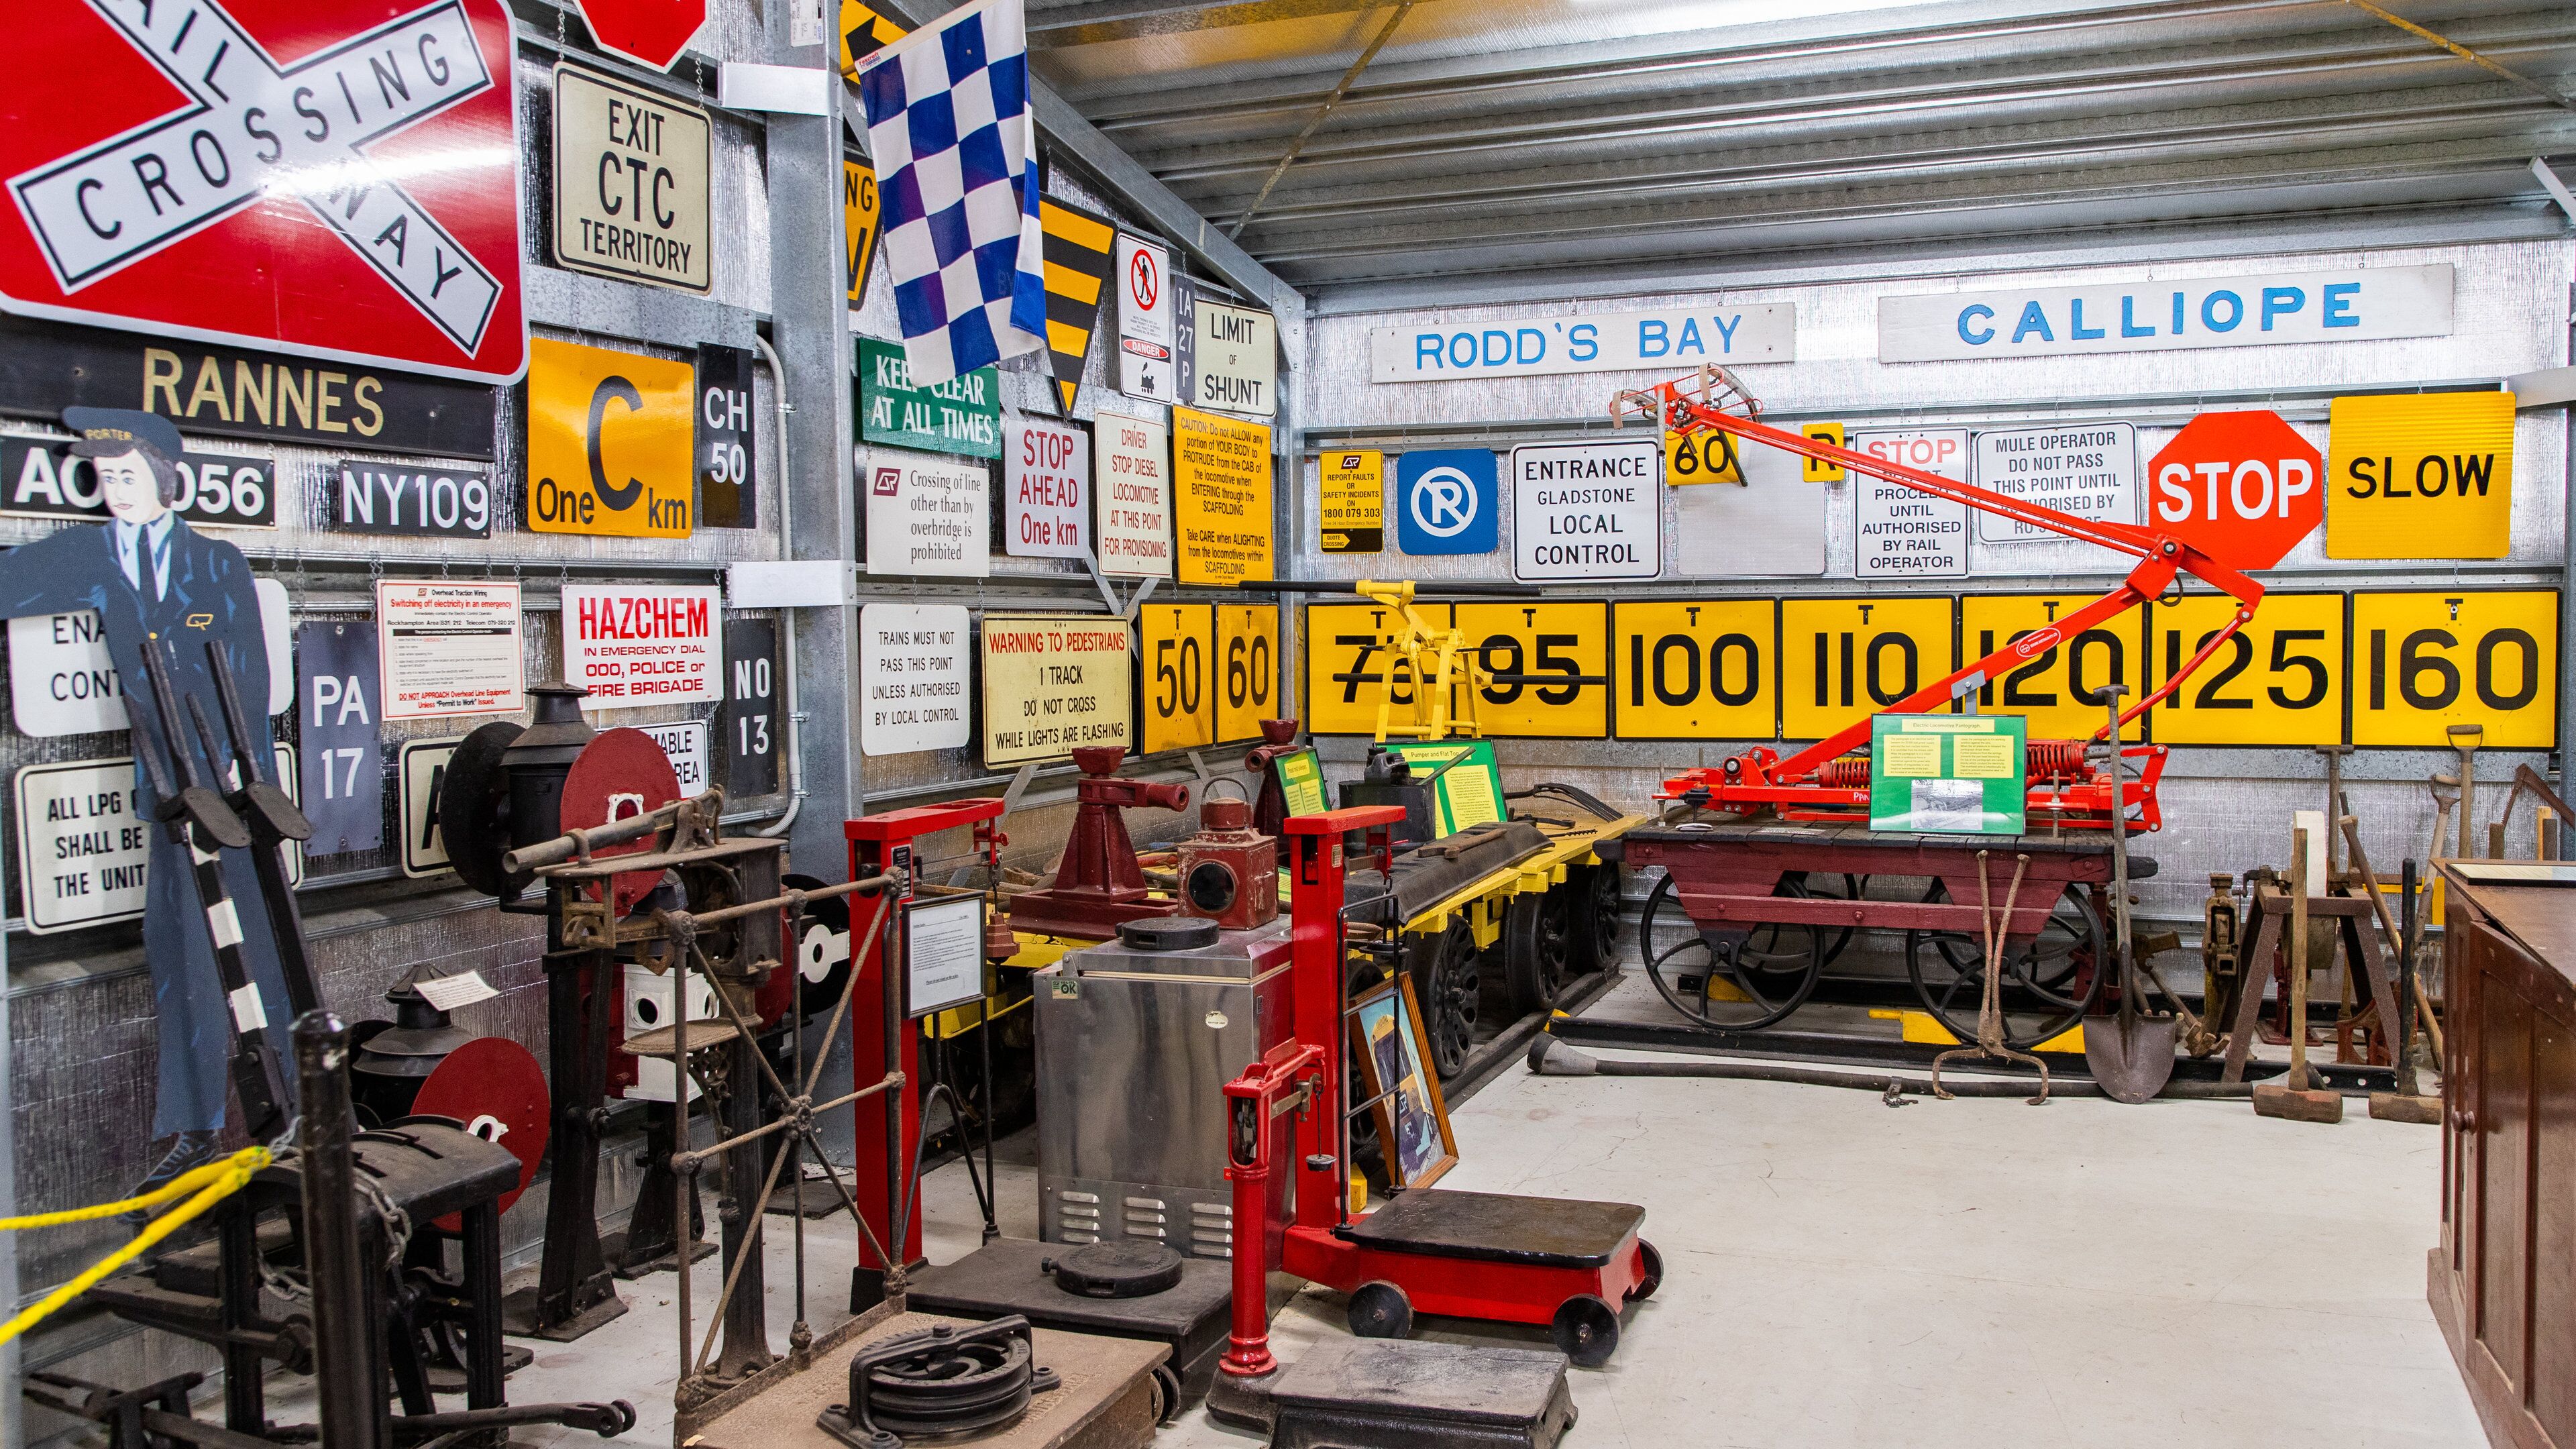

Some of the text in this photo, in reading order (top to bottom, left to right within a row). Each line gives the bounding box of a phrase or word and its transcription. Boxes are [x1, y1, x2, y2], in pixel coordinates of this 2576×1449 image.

[76, 34, 450, 240] CROSSING
[609, 98, 665, 156] EXIT
[599, 152, 675, 229] CTC
[580, 218, 691, 274] TERRITORY
[1957, 282, 2361, 345] CALLIOPE
[1178, 325, 1193, 354] 27
[1212, 313, 1254, 344] LIMIT
[1132, 341, 1160, 358] DANGER
[1417, 315, 1741, 370] RODD'S BAY
[1229, 354, 1236, 365] OF
[1182, 361, 1190, 387] P
[144, 348, 383, 436] RANNES
[930, 374, 985, 406] CLEAR
[1205, 374, 1262, 406] SHUNT
[705, 387, 747, 431] CH
[872, 396, 994, 445] AT ALL TIMES
[85, 429, 133, 441] PORTER
[588, 375, 643, 511] C
[1122, 429, 1146, 449] DRIVER
[1231, 427, 1251, 441] ALLOW
[1996, 431, 2116, 453] MULE OPERATOR
[1023, 429, 1073, 470] STOP
[1183, 450, 1215, 466] PROTRUDE
[1674, 435, 1729, 475] 60
[1868, 439, 1956, 464] STOP
[711, 443, 746, 484] 50
[1112, 455, 1158, 478] STOP DIESEL
[1525, 457, 1647, 480] ENTRANCE
[2009, 453, 2103, 472] DO NOT PASS
[911, 470, 981, 494] Crossing line
[1205, 469, 1235, 484] locomotive
[1993, 473, 2121, 494] THIS POINT UNTIL
[2347, 453, 2494, 498] SLOW
[343, 471, 490, 531] NY109
[1019, 473, 1077, 508] AHEAD
[1113, 483, 1159, 504] LOCOMOTIVE
[1191, 483, 1220, 498] ENTERING
[1538, 488, 1635, 505] GLADSTONE
[2097, 494, 2115, 508] BY
[2157, 459, 2312, 523] STOP
[537, 478, 686, 529] One km
[911, 494, 961, 513] other than
[1203, 500, 1243, 516] SCAFFOLDING
[1324, 509, 1342, 518] 1800
[1890, 505, 1933, 517] UNTIL
[911, 519, 962, 541] overbridge
[1021, 513, 1077, 545] One km
[1123, 511, 1161, 531] THIS POINT
[1550, 514, 1623, 535] LOCAL
[1862, 521, 1961, 535] AUTHORISED
[1105, 537, 1167, 558] FOR PROVISIONING
[1233, 533, 1265, 547] ALIGHTING
[1883, 539, 1941, 551] BY RAIL
[911, 542, 961, 564] prohibited
[1535, 544, 1640, 566] CONTROL
[1870, 556, 1953, 569] OPERATOR
[1205, 561, 1244, 574] SCAFFOLDING
[391, 599, 512, 609] Switching off electricity emergency
[579, 597, 708, 639] HAZCHEM
[1173, 609, 1181, 630] T
[1246, 610, 1252, 629] T
[1371, 611, 1386, 629] T
[1522, 608, 1536, 627] T
[1686, 607, 1701, 627] T
[879, 631, 955, 645] TRAINS MUST NOT
[989, 632, 1125, 653] WARNING TO PEDESTRIANS
[584, 644, 705, 656] IN EMERGENCY DIAL
[630, 660, 705, 675] POLICE or
[880, 657, 953, 672] PASS THIS POINT
[1049, 665, 1083, 685] TRACK
[1228, 635, 1269, 709] 60
[1479, 634, 1580, 704] 95
[1631, 633, 1759, 706] 100
[1815, 632, 1918, 707] 110
[1980, 629, 2124, 707] 120
[2166, 629, 2328, 710] 125
[2370, 628, 2538, 710] 160
[588, 678, 704, 697] FIRE BRIGADE
[735, 658, 770, 700] NO
[1157, 636, 1201, 718] 50
[313, 676, 369, 727] PA
[421, 691, 449, 699] APPROACH
[873, 682, 961, 700] UNLESS AUTHORISED
[875, 708, 959, 726] BY LOCAL CONTROL
[1024, 696, 1095, 716] DO NOT CROSS
[740, 714, 769, 755] 13
[996, 722, 1124, 749] WHILE LIGHTS ARE FLASHING
[321, 748, 364, 799] 17
[48, 790, 121, 822] ALL LPG
[56, 827, 143, 859] SHALL BE
[54, 874, 89, 898] THE
[1061, 984, 1077, 994] OK
